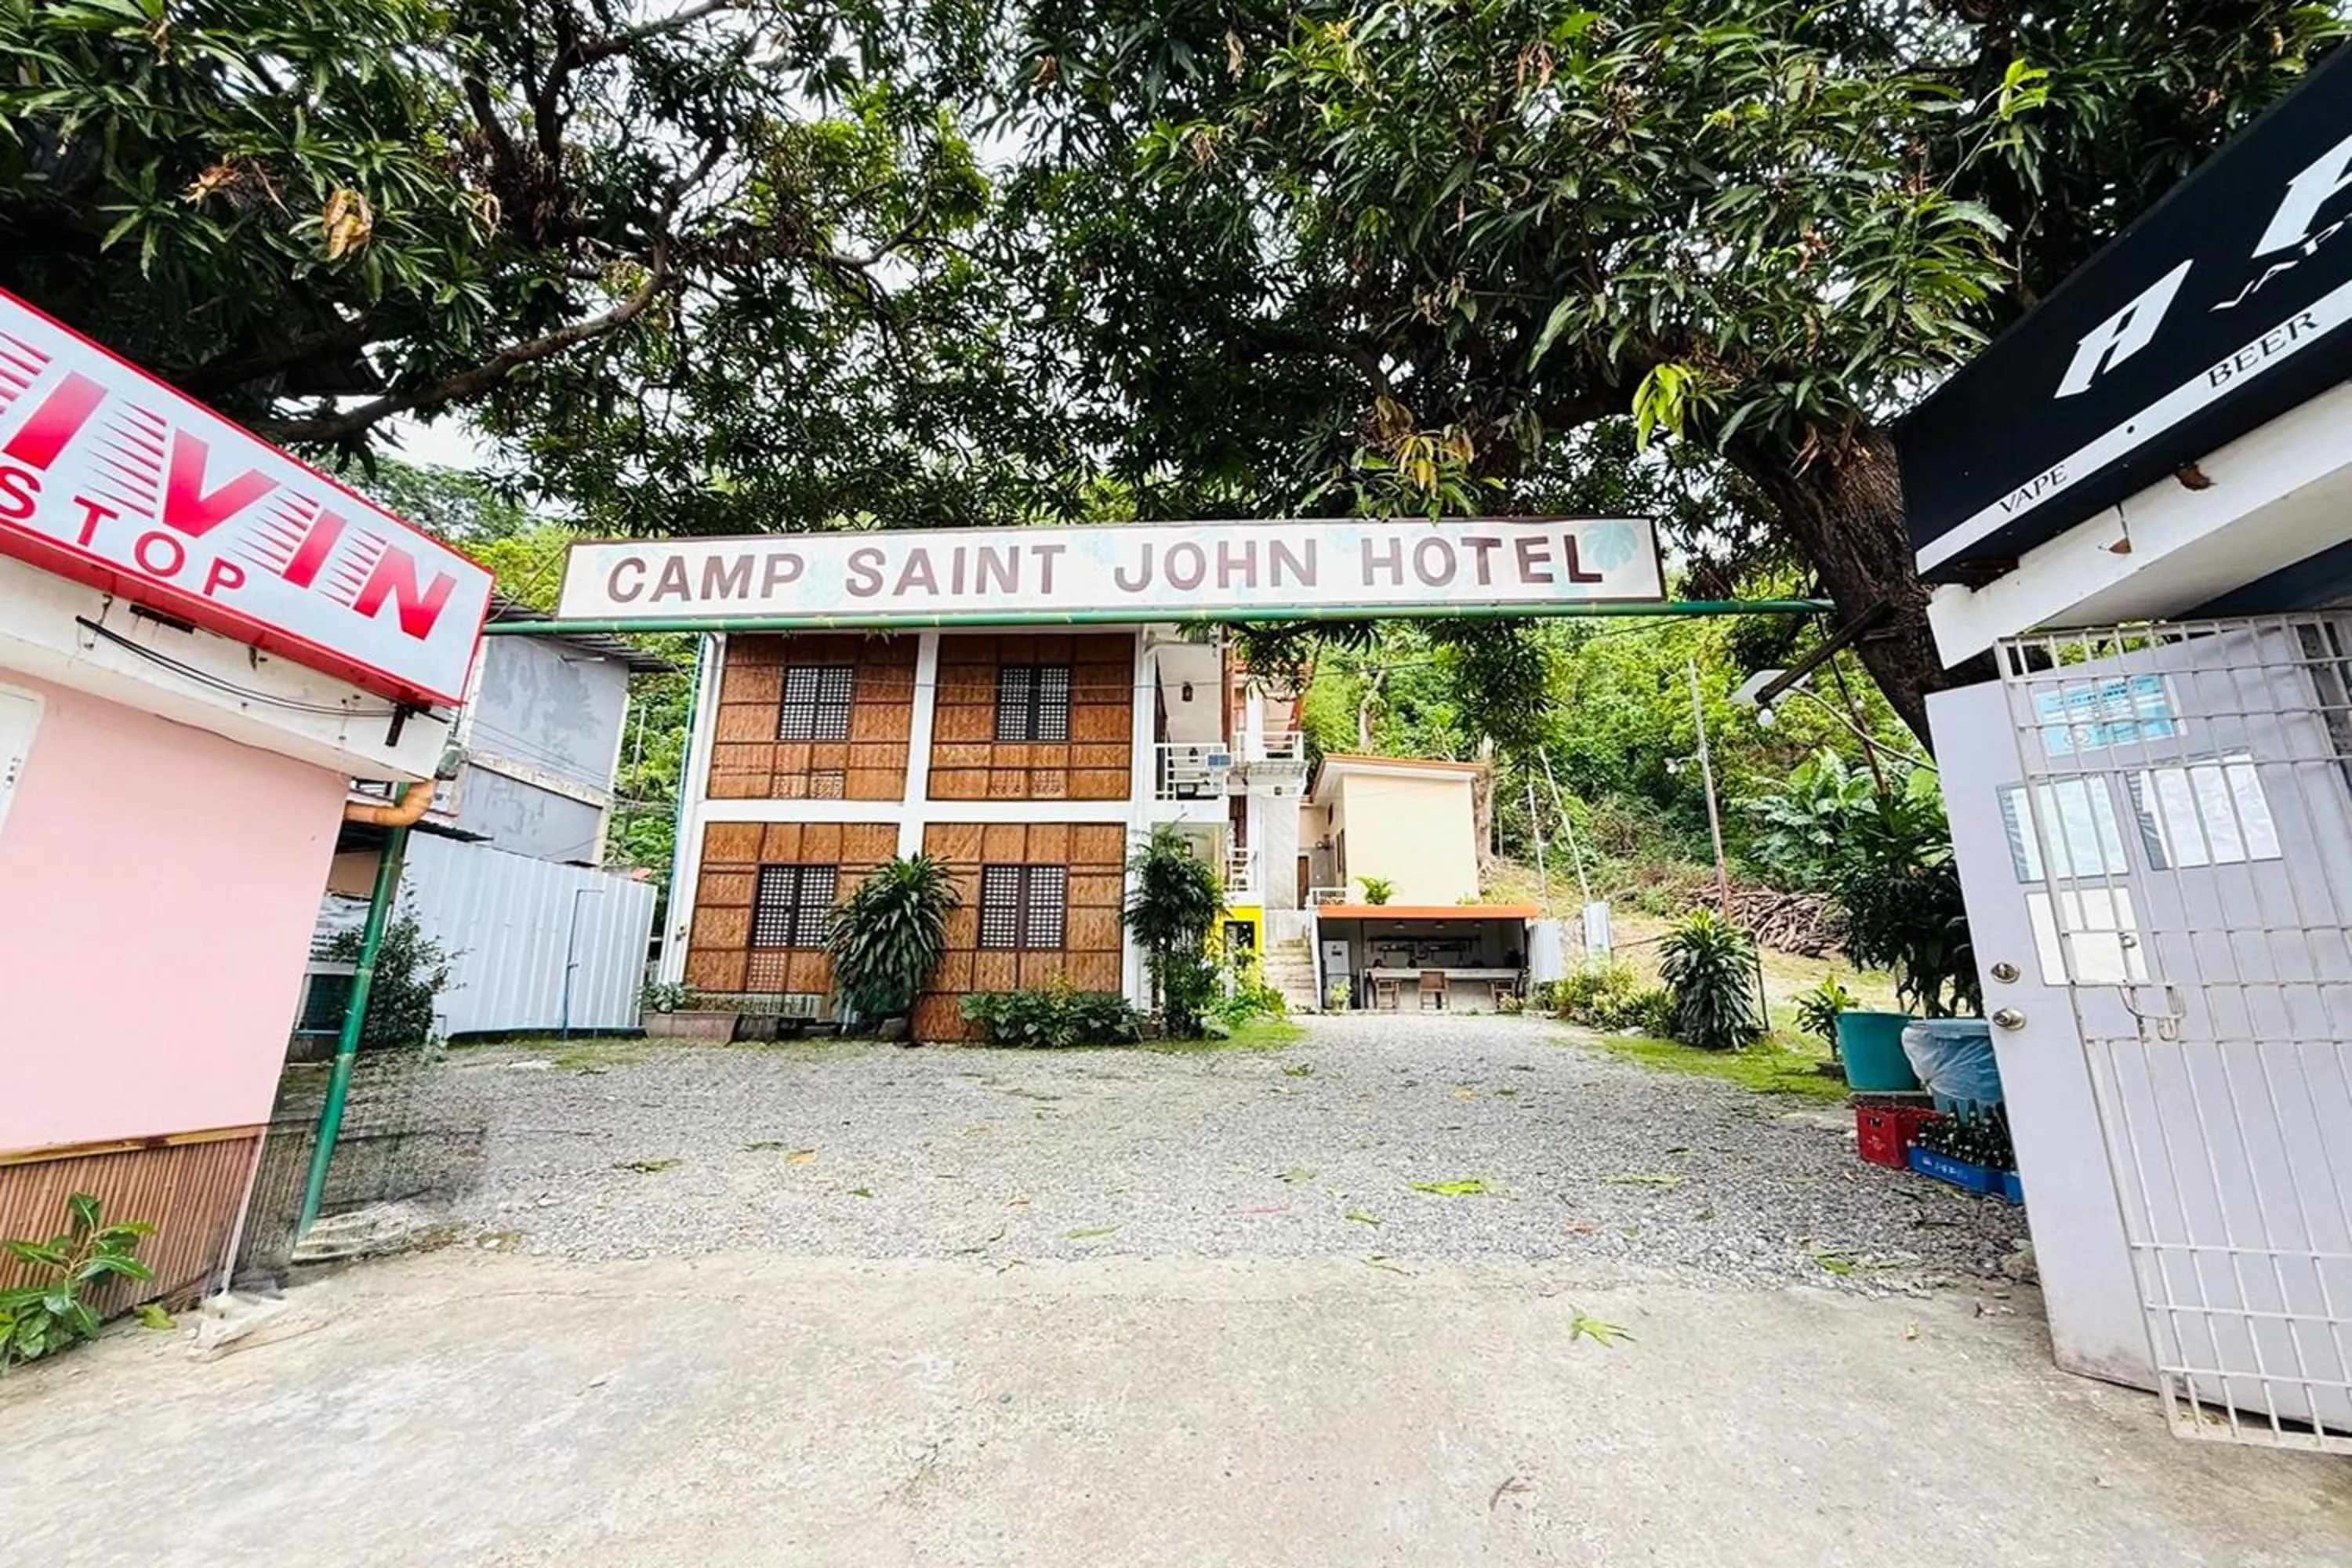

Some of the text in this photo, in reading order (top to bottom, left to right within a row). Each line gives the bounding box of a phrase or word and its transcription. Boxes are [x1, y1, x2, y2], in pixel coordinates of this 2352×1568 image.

[2208, 212, 2352, 312] VAP
[1998, 311, 2320, 514] VAPE BEER
[0, 466, 248, 597] STOP
[607, 534, 1603, 603] CAMP SAINT JOHN HOTEL
